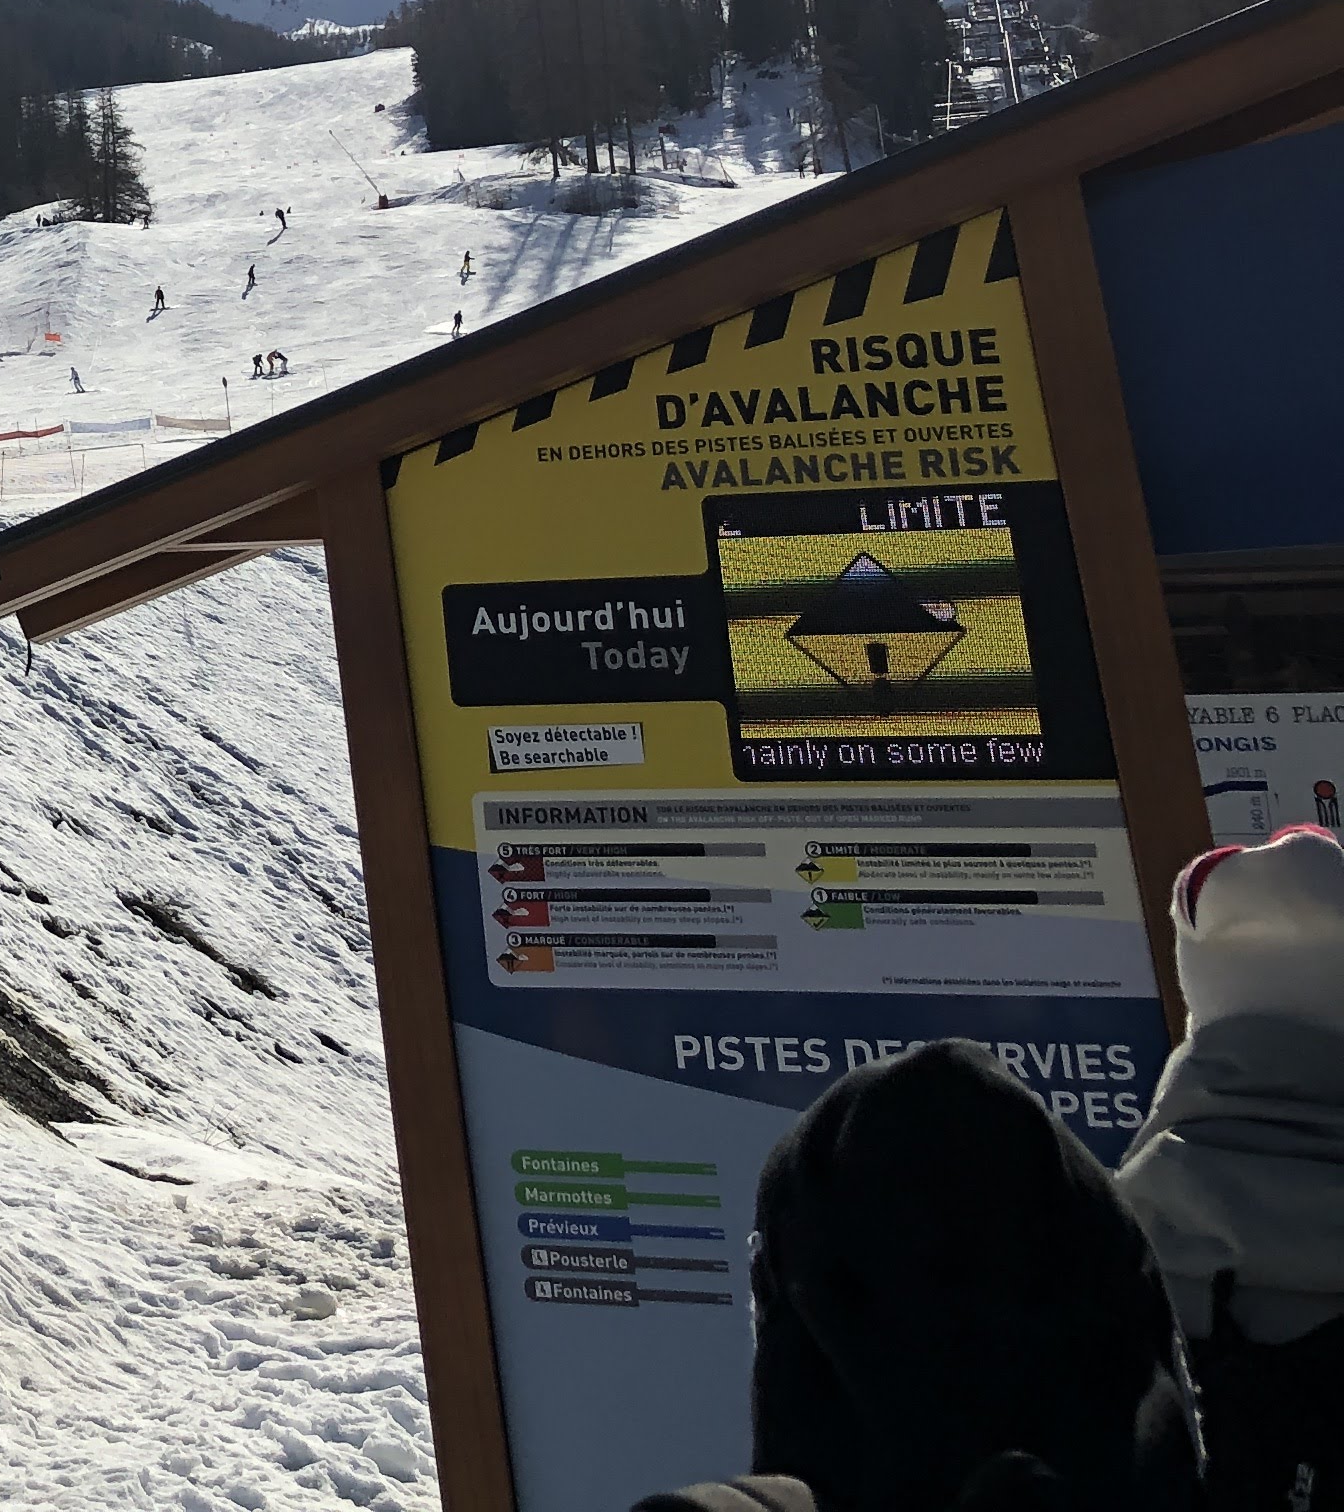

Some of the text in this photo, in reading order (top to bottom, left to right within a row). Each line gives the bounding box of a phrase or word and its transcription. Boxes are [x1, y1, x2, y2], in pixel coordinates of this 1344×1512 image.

[811, 327, 1002, 375] RISQUE
[655, 375, 1008, 430] D'AVALANCHE
[537, 422, 1013, 462] EN DEHORS DES PISTES BALISÉES ET OUVERTES
[661, 445, 1022, 491] AVALANCHE RISK
[860, 493, 1007, 531] LIMITE
[472, 599, 687, 640] Aujourd'hui
[581, 640, 689, 674] Today
[1266, 706, 1279, 723] 6
[495, 729, 540, 746] Soyez
[544, 727, 627, 743] détectable
[499, 748, 609, 766] Be searchable
[838, 743, 875, 765] on
[887, 742, 977, 764] some
[987, 737, 1045, 763] few
[498, 806, 649, 826] INFORMATION
[502, 845, 510, 855] 5
[543, 845, 566, 855] FORT
[810, 845, 820, 855] 2
[520, 891, 545, 900] FORT
[831, 892, 867, 901] FAIBLE
[674, 1035, 831, 1073] PISTES
[521, 1156, 599, 1173] Fontaines
[525, 1187, 612, 1205] Marmottes
[528, 1218, 598, 1236] Prévieux
[550, 1251, 628, 1269] Pousterle
[553, 1283, 632, 1302] Fontaines
